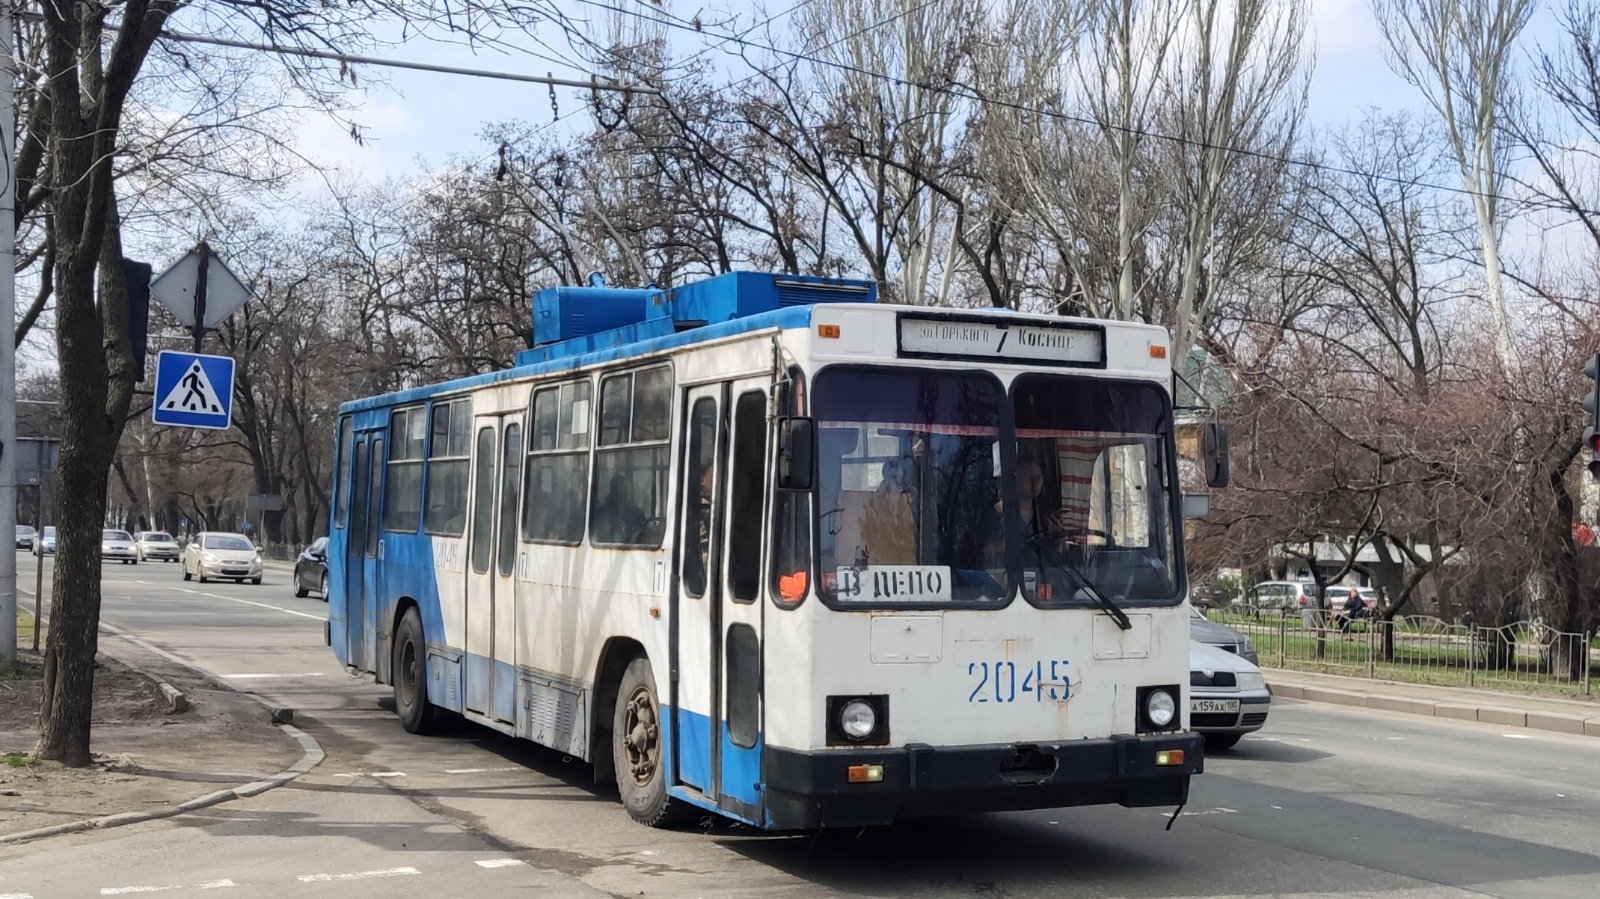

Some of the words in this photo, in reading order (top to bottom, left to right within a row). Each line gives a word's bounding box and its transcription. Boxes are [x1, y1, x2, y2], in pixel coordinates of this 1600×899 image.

[935, 323, 989, 343] Горького
[995, 322, 1010, 354] 7
[1018, 328, 1075, 350] Космос
[843, 570, 862, 598] В
[873, 571, 943, 598] ДЕПО
[968, 660, 1070, 703] 2045
